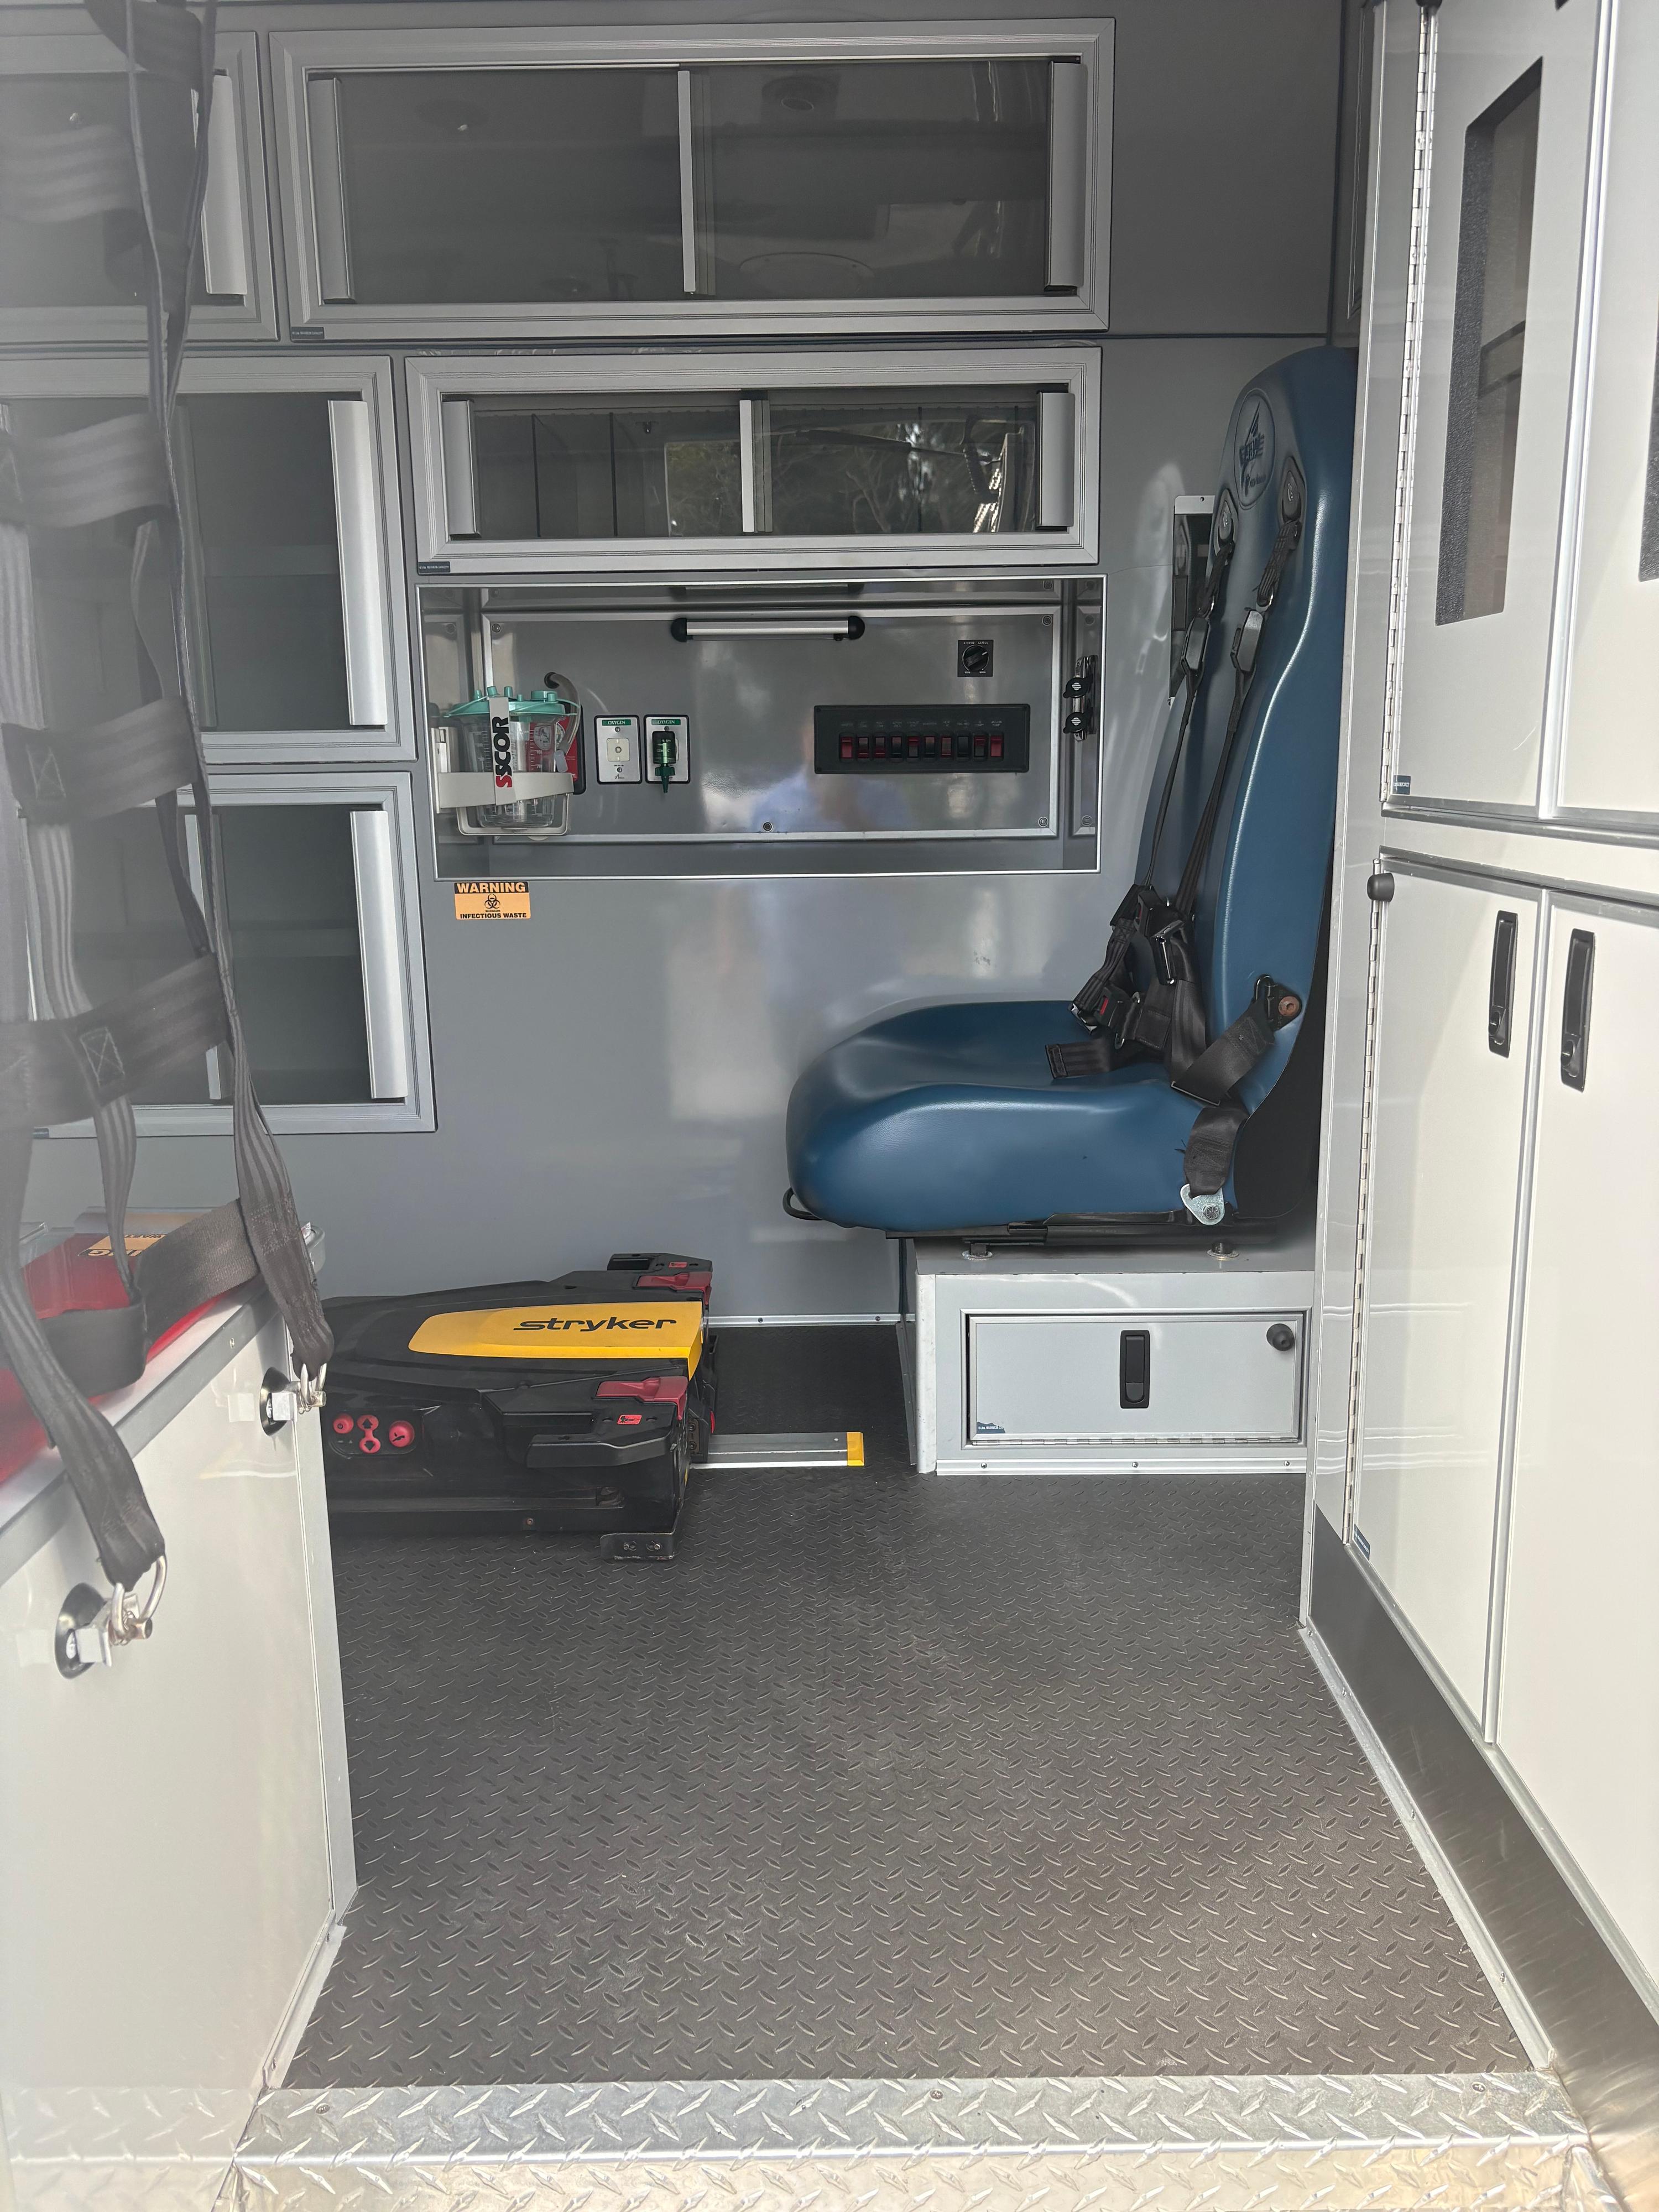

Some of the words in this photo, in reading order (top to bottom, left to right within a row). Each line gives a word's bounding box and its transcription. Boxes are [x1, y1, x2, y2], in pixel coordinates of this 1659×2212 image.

[492, 716, 513, 788] SSCOR
[457, 882, 526, 893] WARNING
[513, 1317, 677, 1332] stryker
